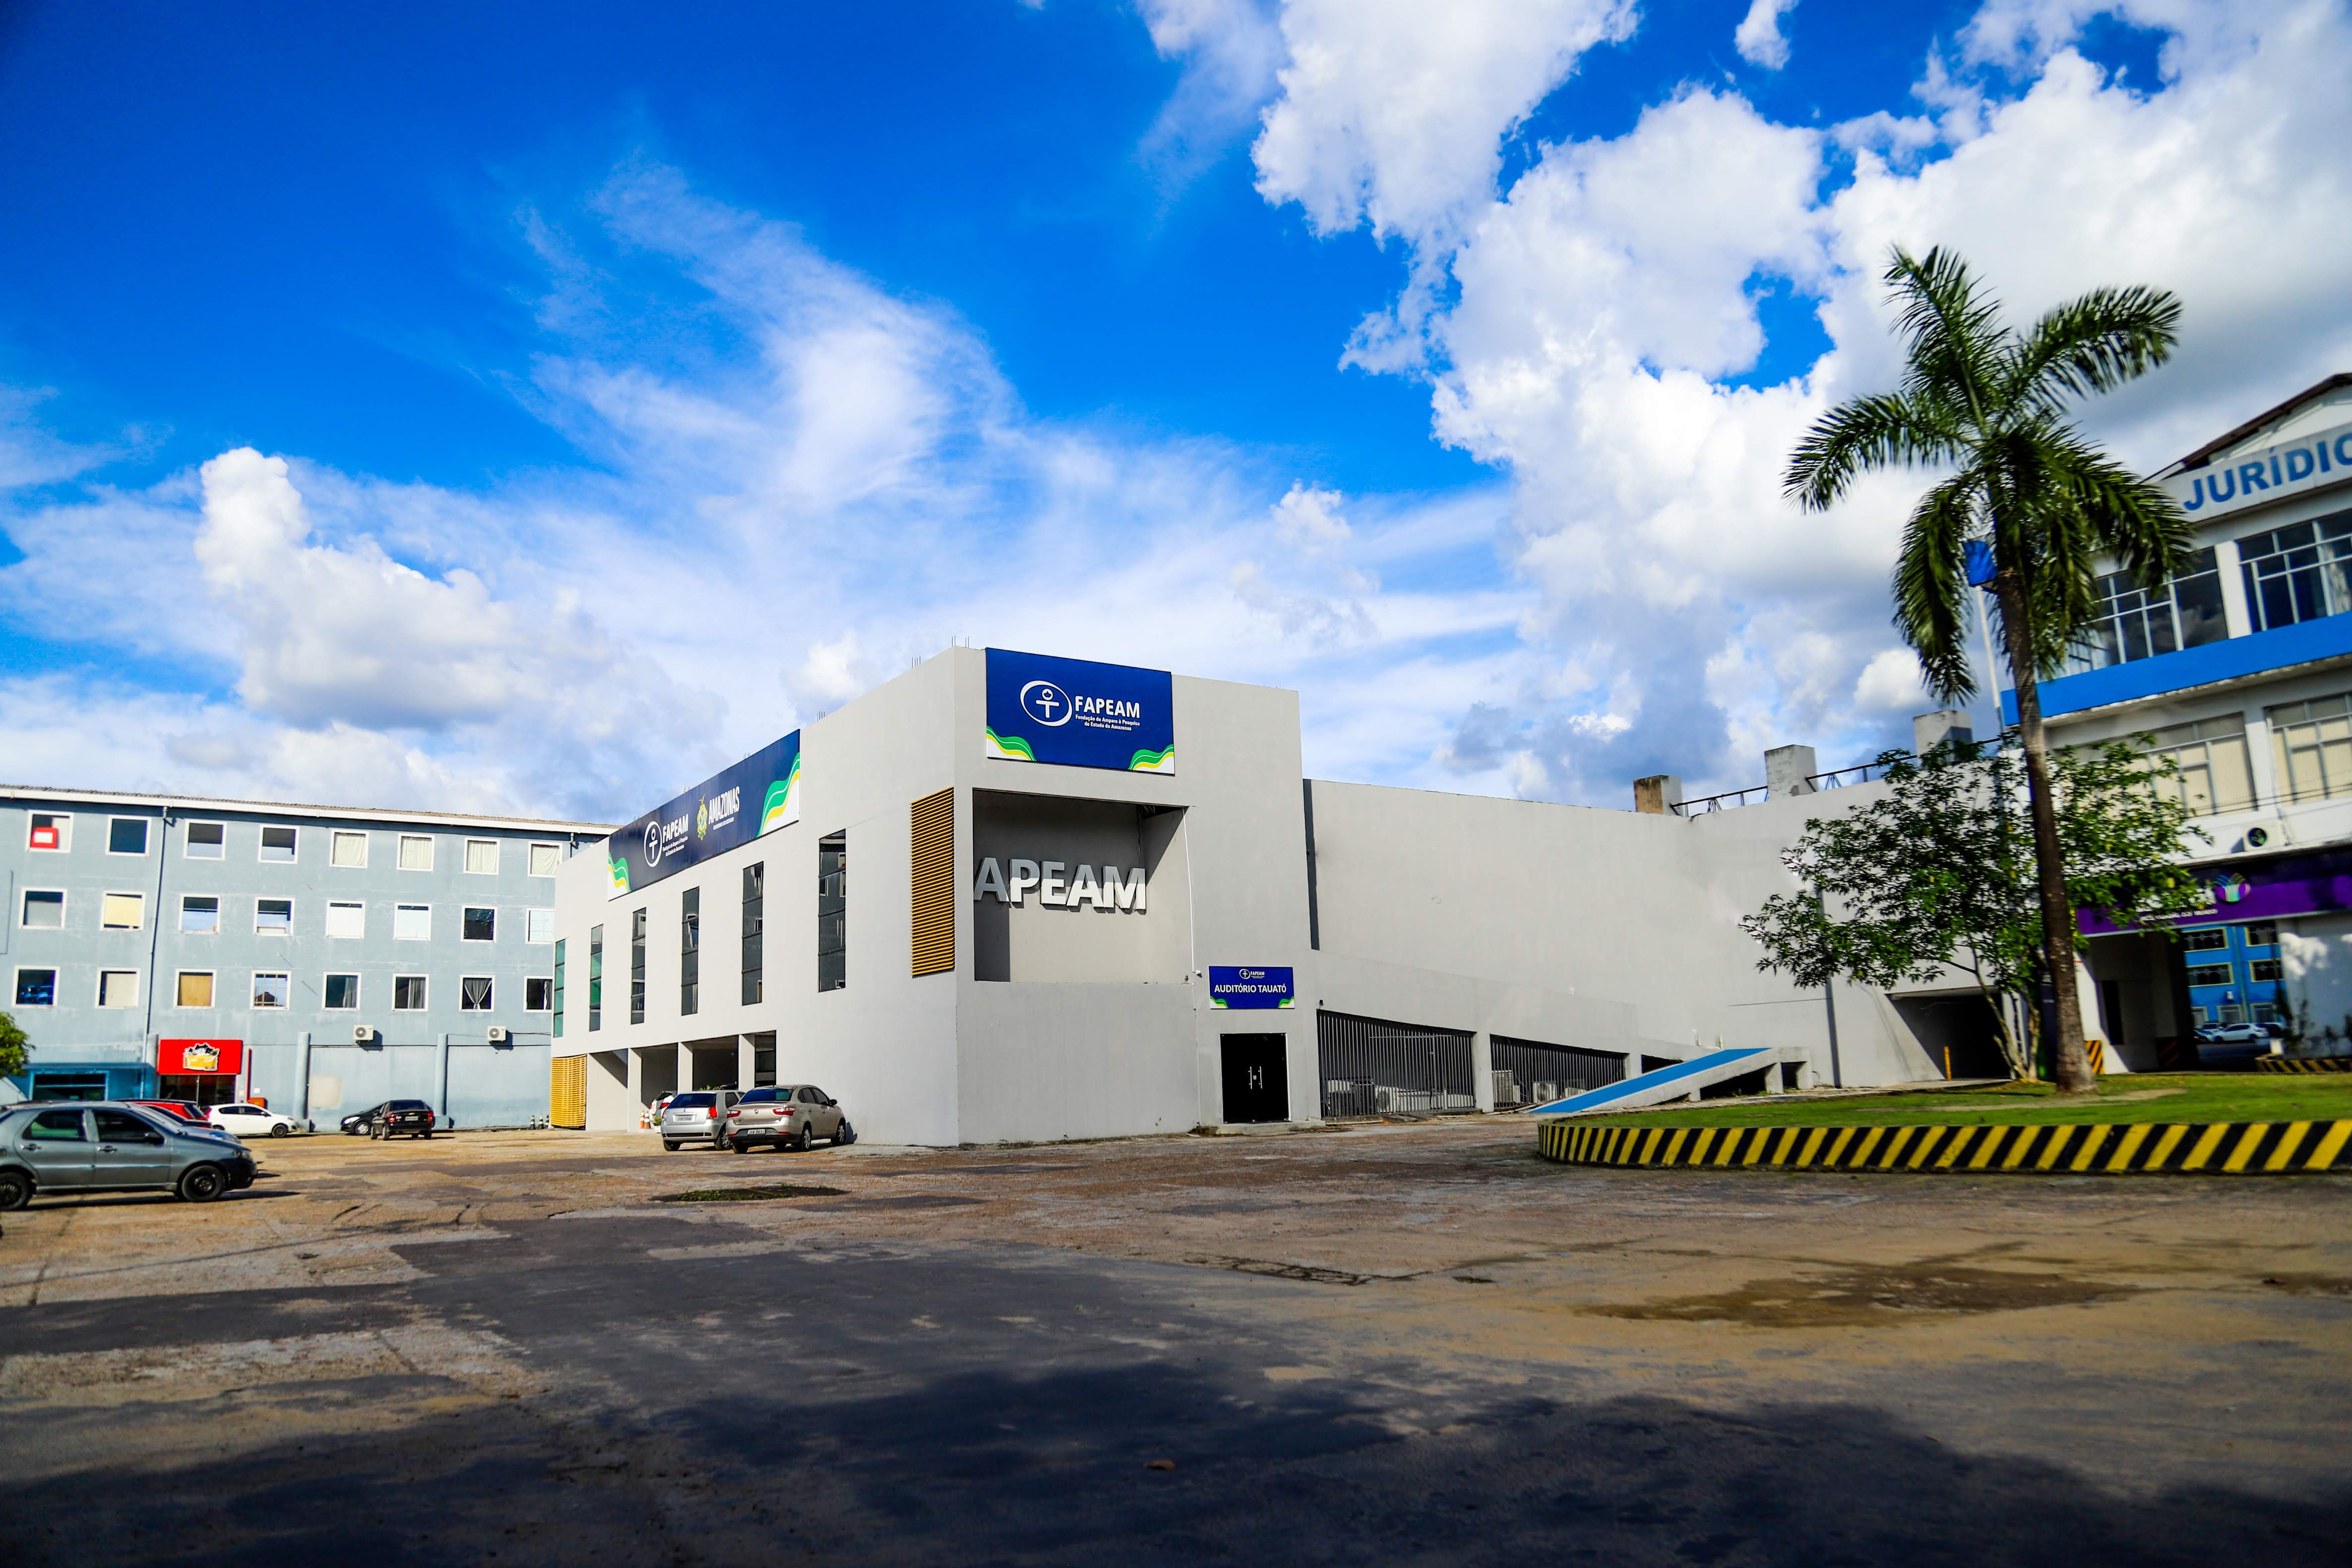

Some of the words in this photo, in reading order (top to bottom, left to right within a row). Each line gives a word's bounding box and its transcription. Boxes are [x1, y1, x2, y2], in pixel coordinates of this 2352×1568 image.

[1075, 696, 1140, 718] FAPEAM
[708, 786, 740, 825] AMAZONAS
[663, 814, 688, 843] FAPEAM
[1214, 983, 1257, 993] AUDITÓRIO
[1258, 983, 1287, 993] TAUATÓ
